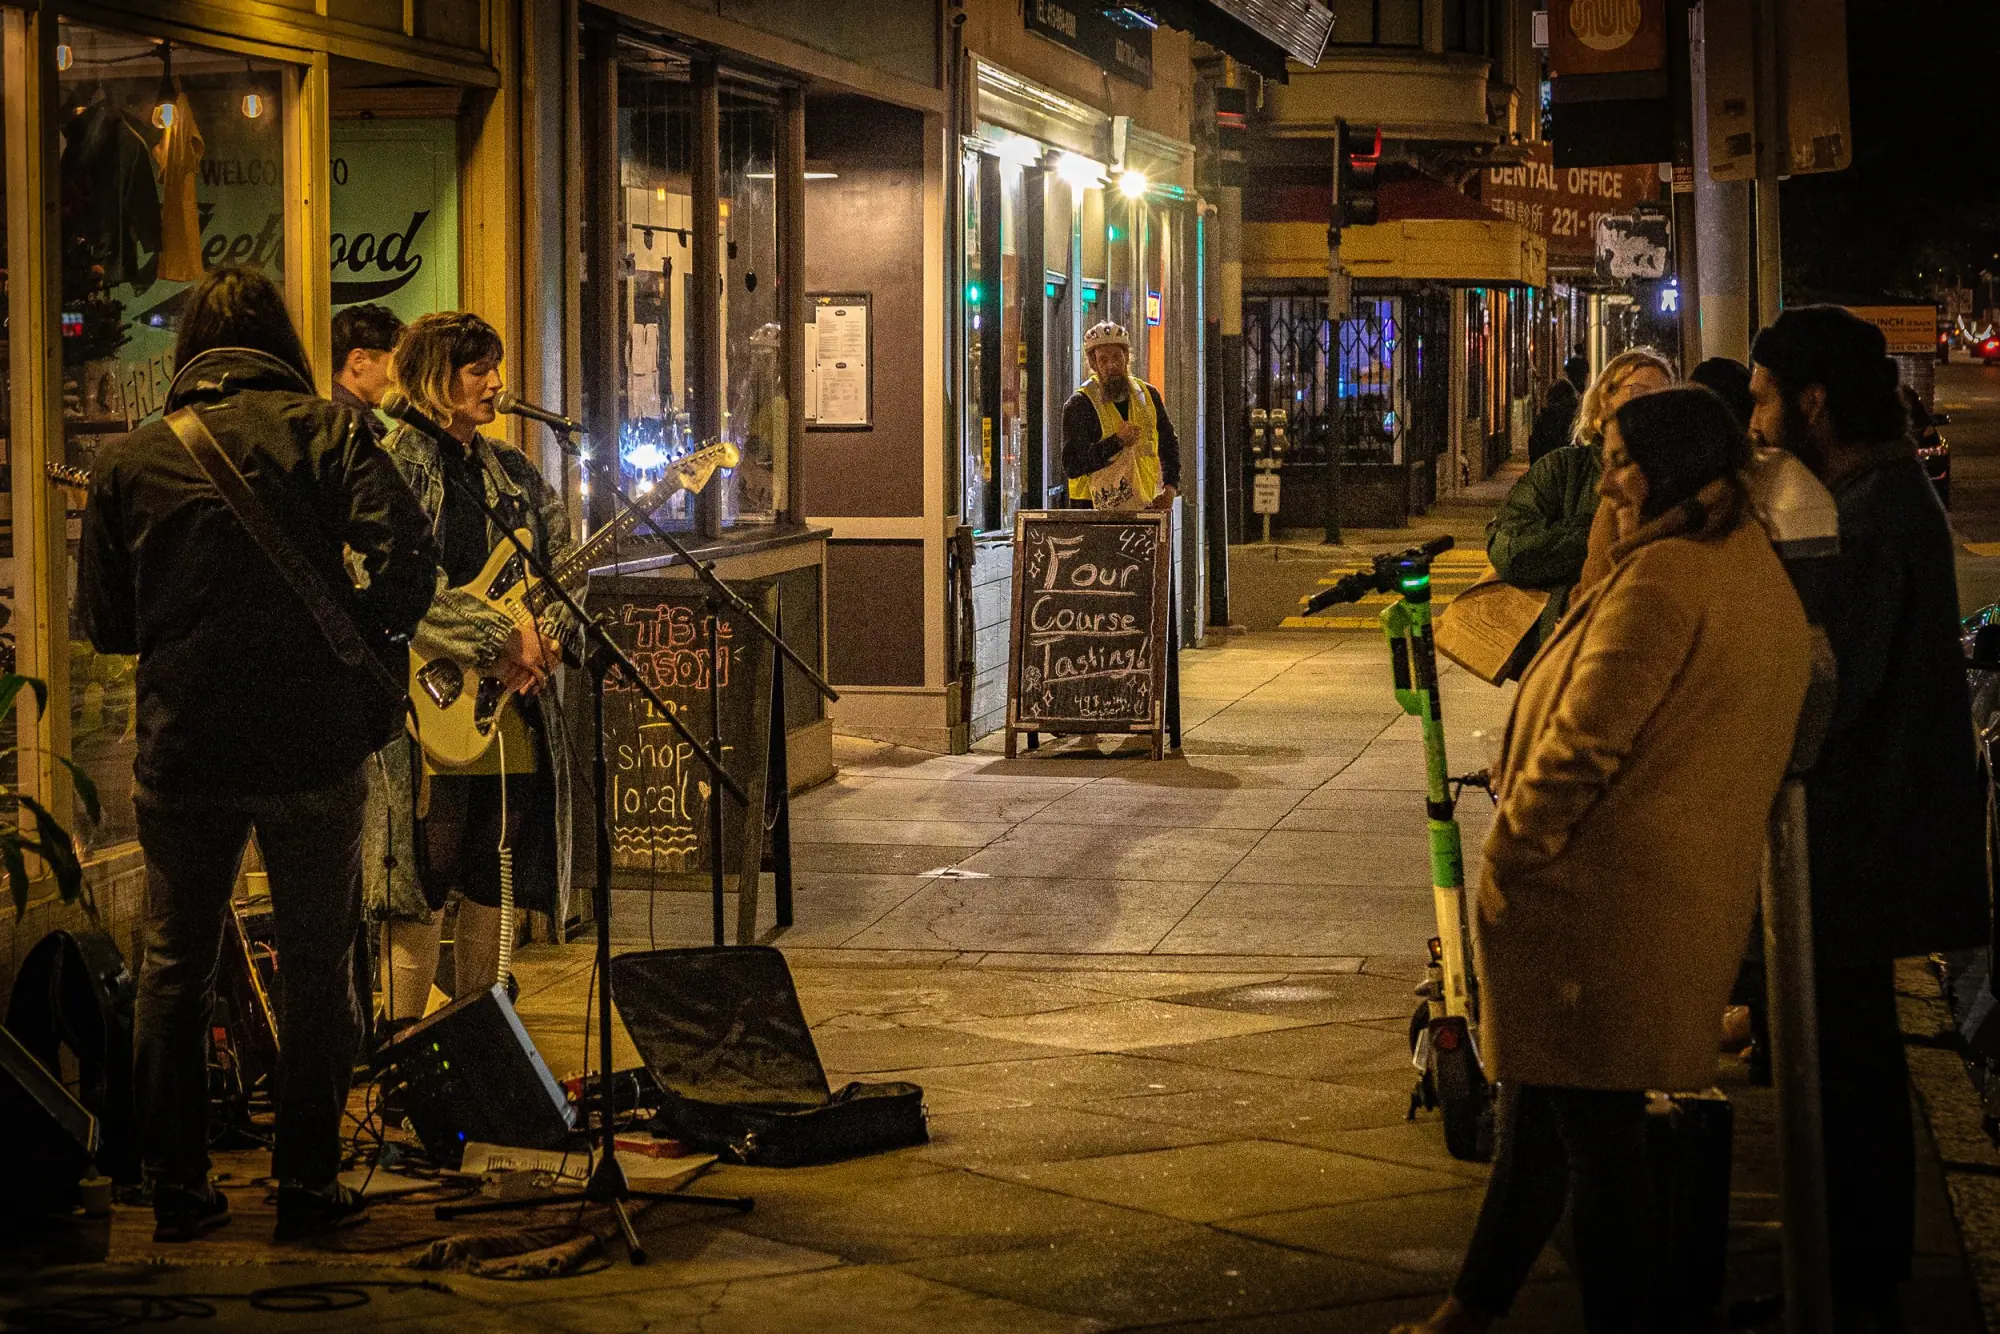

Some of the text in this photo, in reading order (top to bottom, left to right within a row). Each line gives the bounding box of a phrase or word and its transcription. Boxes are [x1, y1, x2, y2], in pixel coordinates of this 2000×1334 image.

[201, 157, 349, 186] WELCO O
[1490, 161, 1622, 199] DENTAL OFFICE
[1043, 534, 1139, 590] Four
[1031, 594, 1136, 632] Course
[1030, 635, 1149, 680] Tasting!
[618, 732, 695, 786] shop
[613, 770, 692, 822] local
